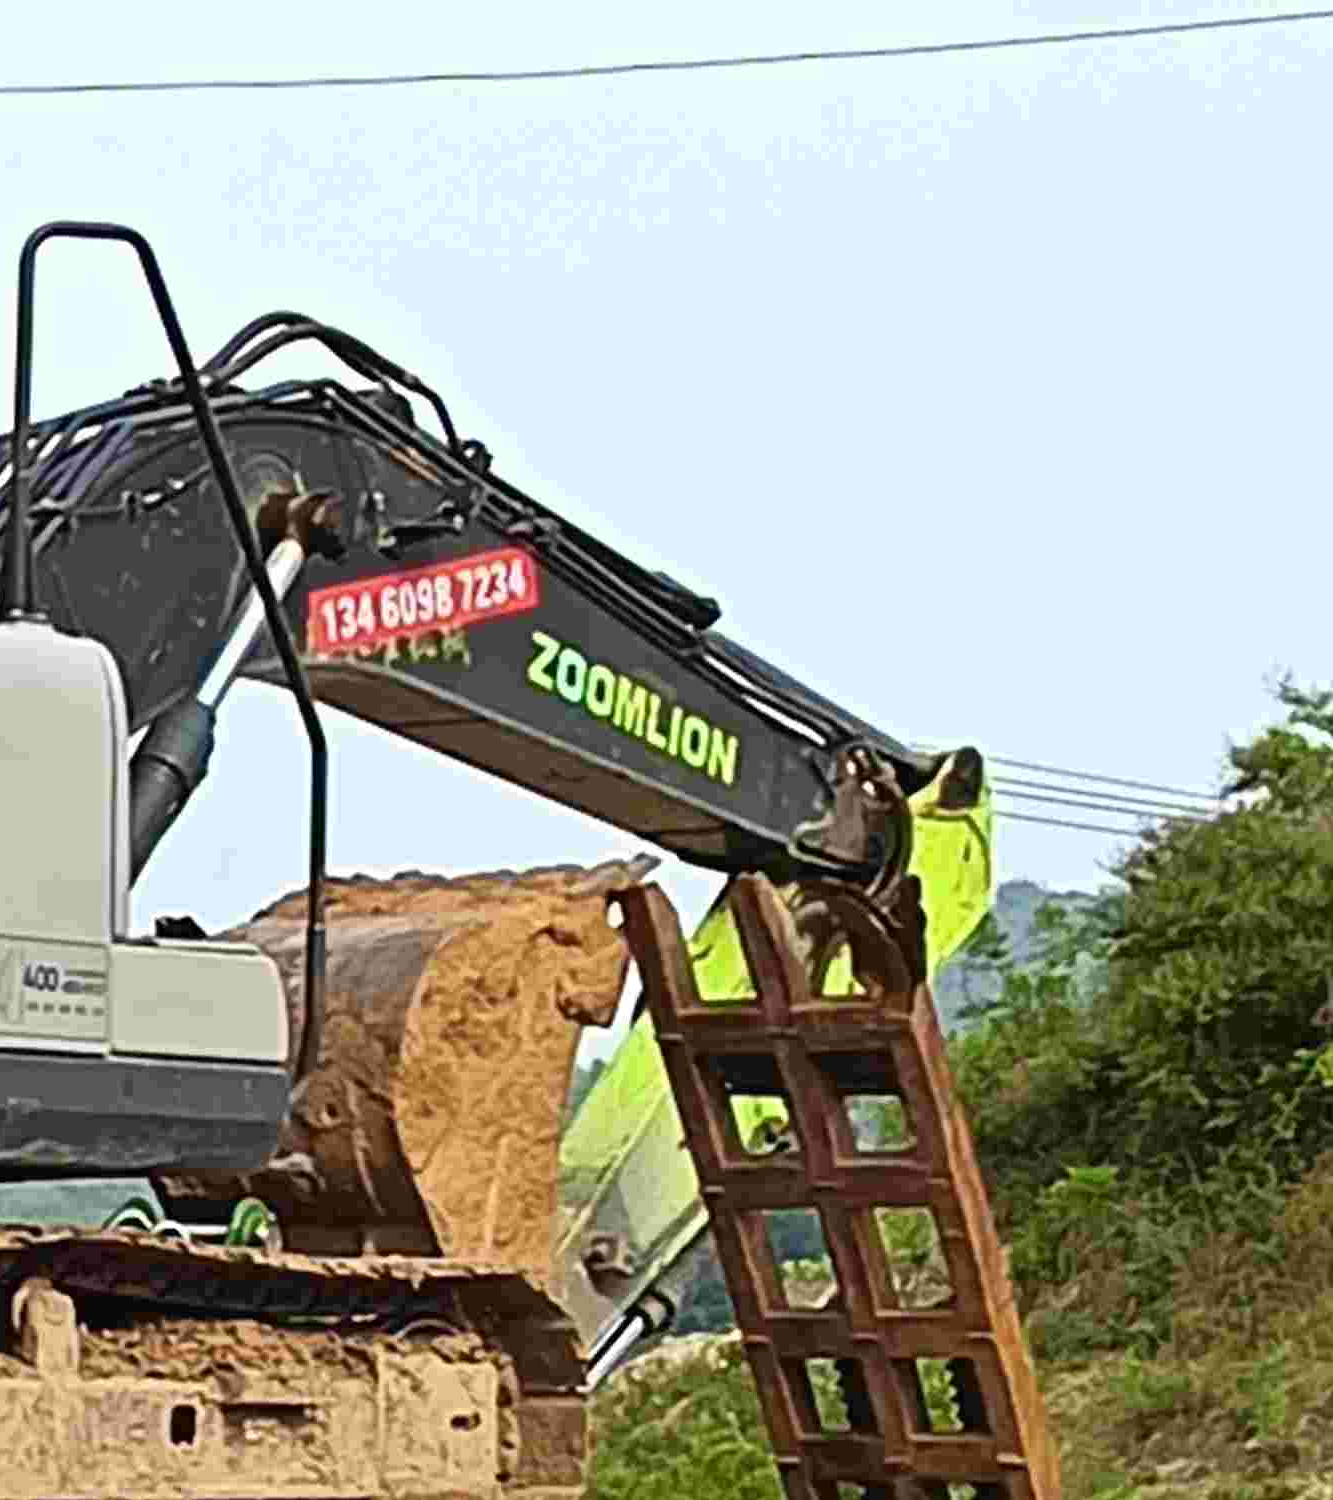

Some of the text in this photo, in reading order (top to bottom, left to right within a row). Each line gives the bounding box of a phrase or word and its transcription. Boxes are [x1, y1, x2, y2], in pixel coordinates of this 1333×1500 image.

[321, 592, 376, 642] 134
[455, 558, 527, 612] 7234
[527, 630, 739, 785] ZOOMLION
